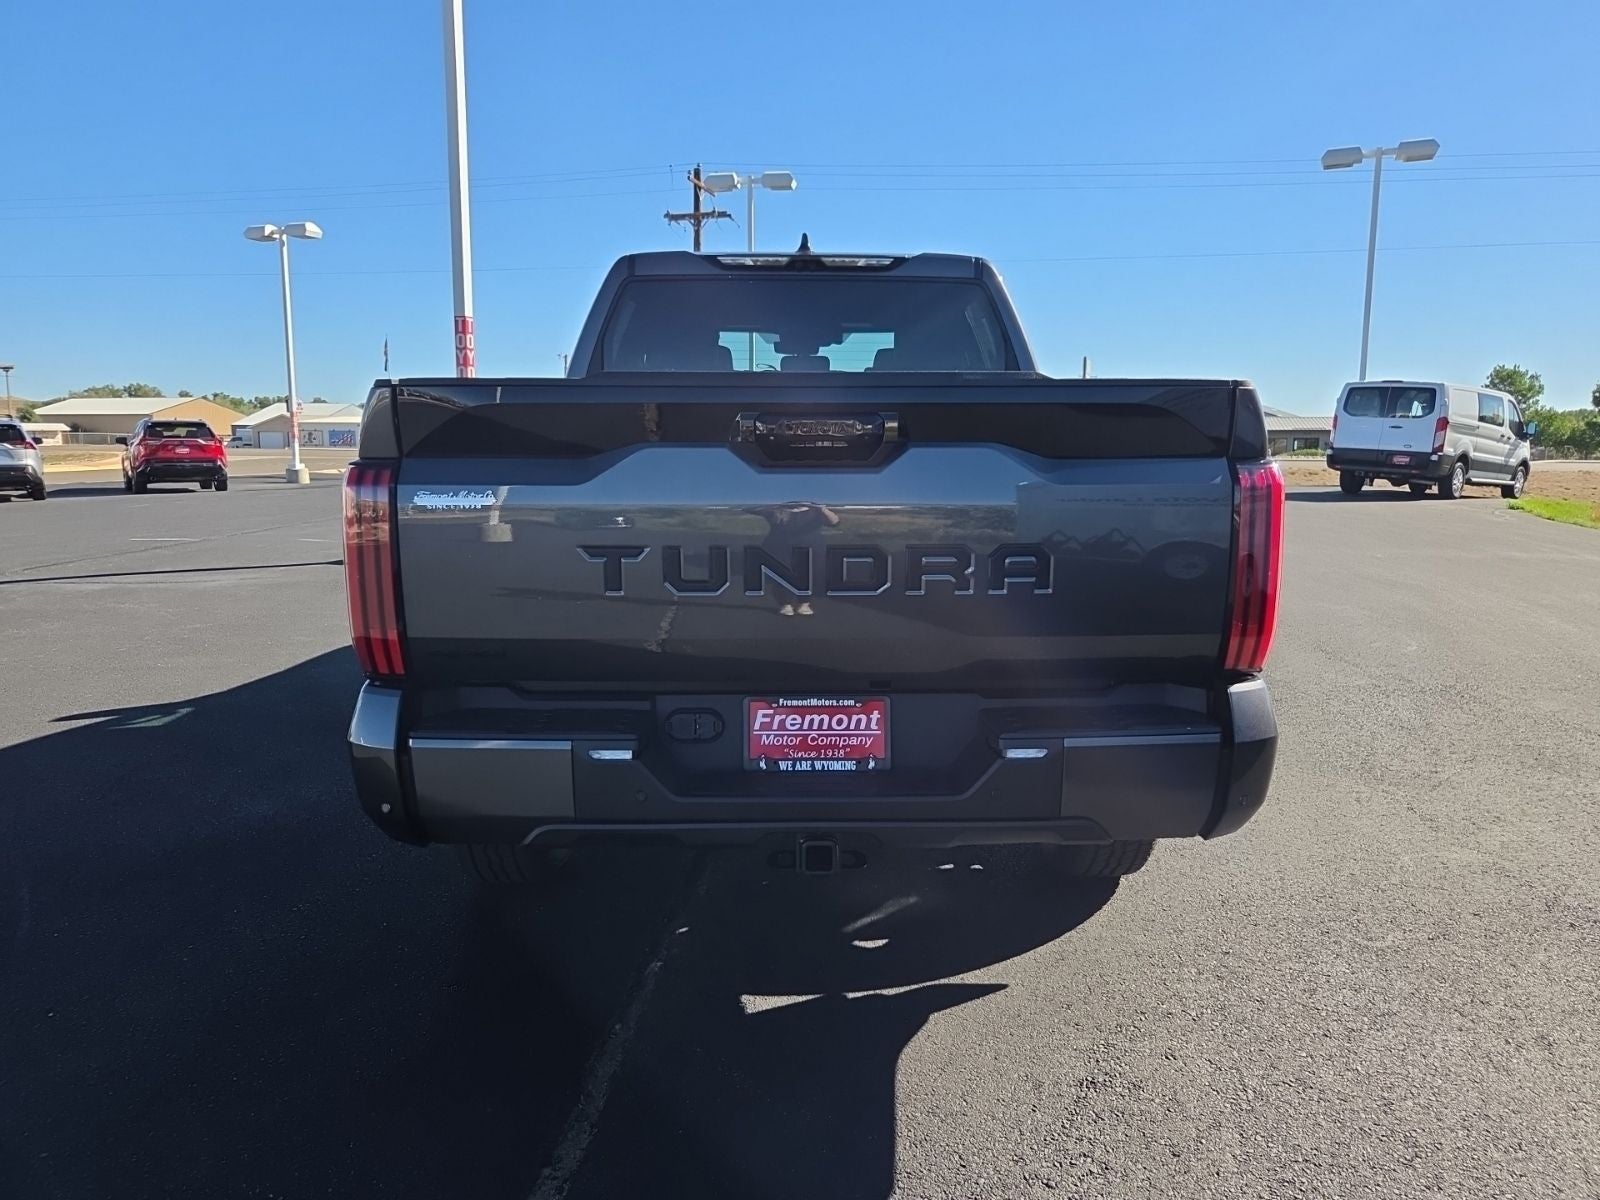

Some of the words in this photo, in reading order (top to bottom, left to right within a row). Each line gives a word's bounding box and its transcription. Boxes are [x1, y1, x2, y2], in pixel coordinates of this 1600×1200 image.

[575, 544, 1055, 597] TUNDRA
[779, 698, 855, 707] FremontMotors.com
[753, 709, 881, 730] Fremont
[761, 734, 803, 746] Motor
[808, 734, 874, 748] Company
[779, 760, 793, 771] WE
[795, 760, 811, 771] ARE
[814, 760, 856, 771] WYOMING
